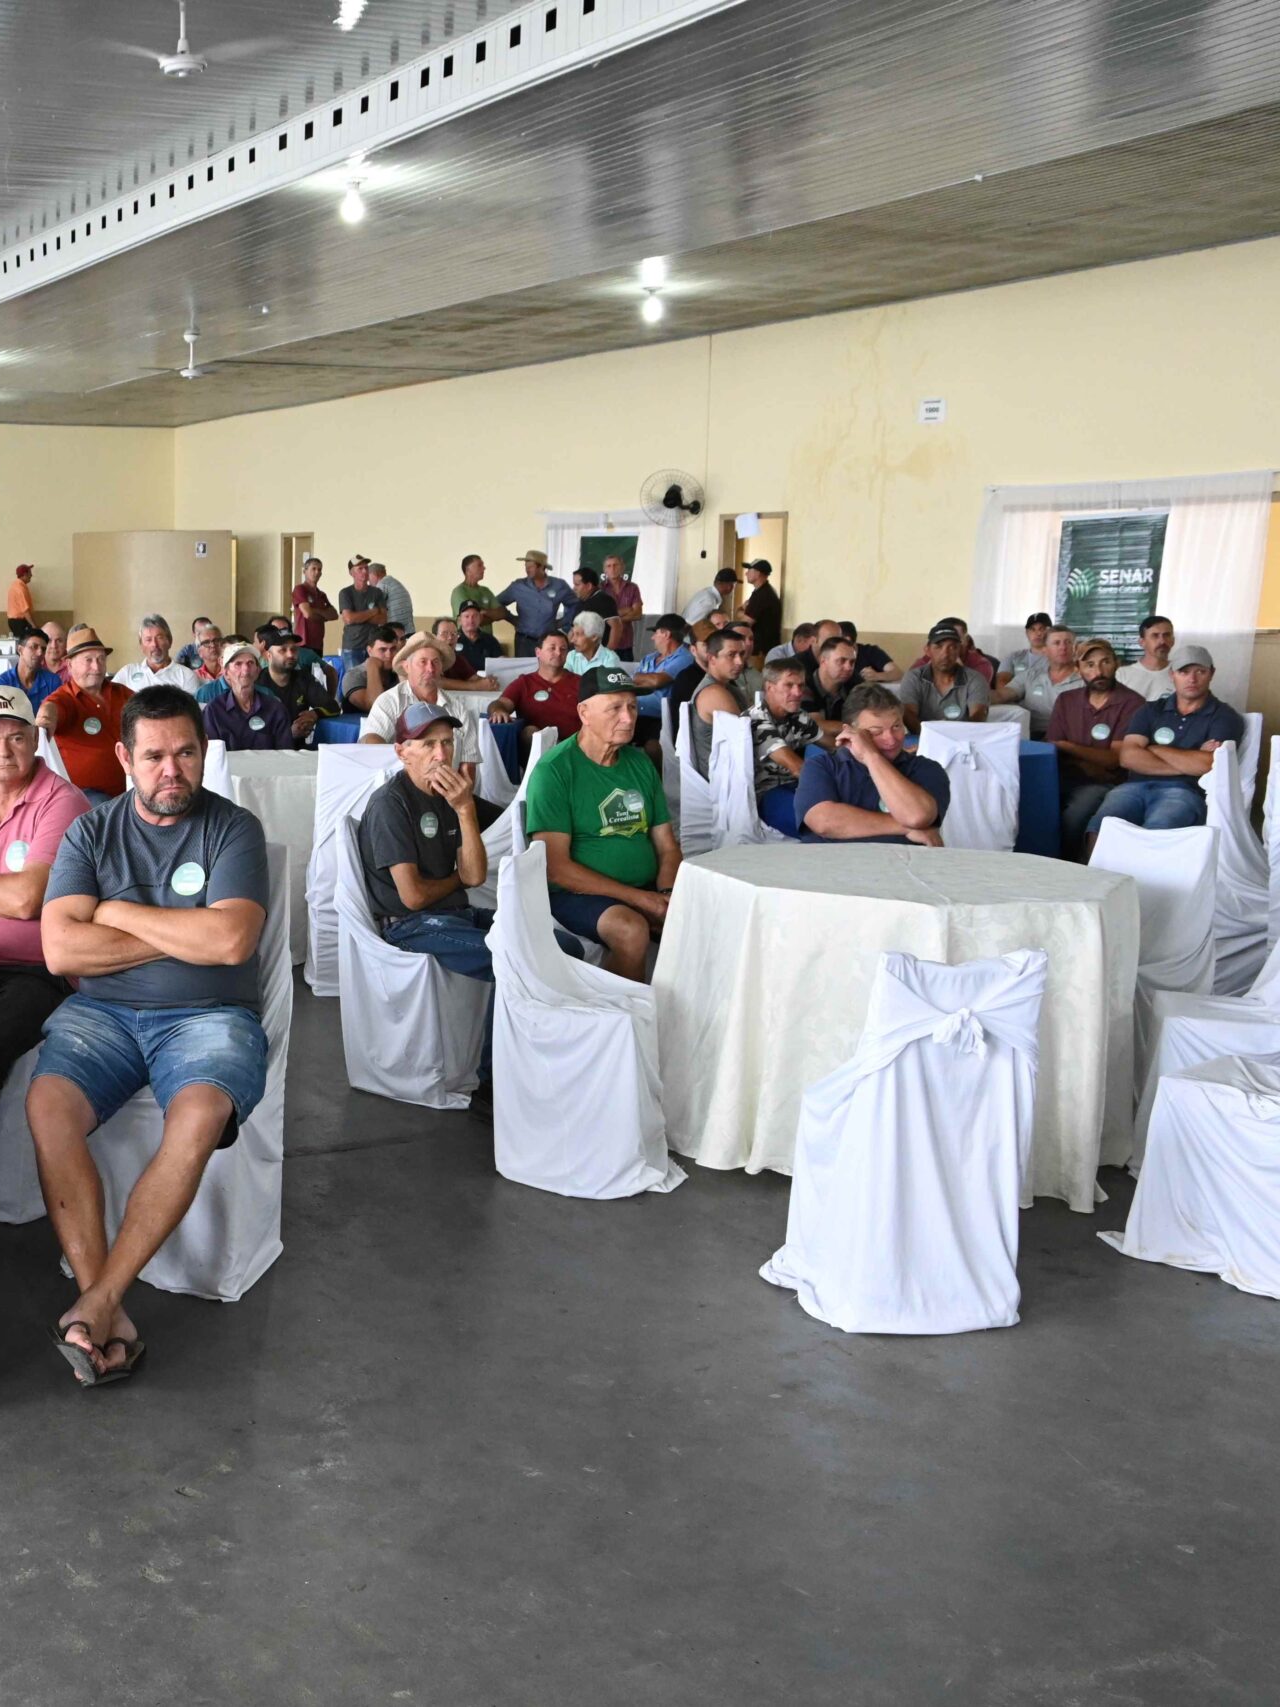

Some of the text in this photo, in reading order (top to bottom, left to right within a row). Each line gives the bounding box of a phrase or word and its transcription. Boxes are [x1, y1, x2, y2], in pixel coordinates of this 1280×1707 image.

[1098, 568, 1154, 585] SENAR
[1097, 585, 1149, 594] Santa Catarina
[608, 814, 640, 824] Cerealista
